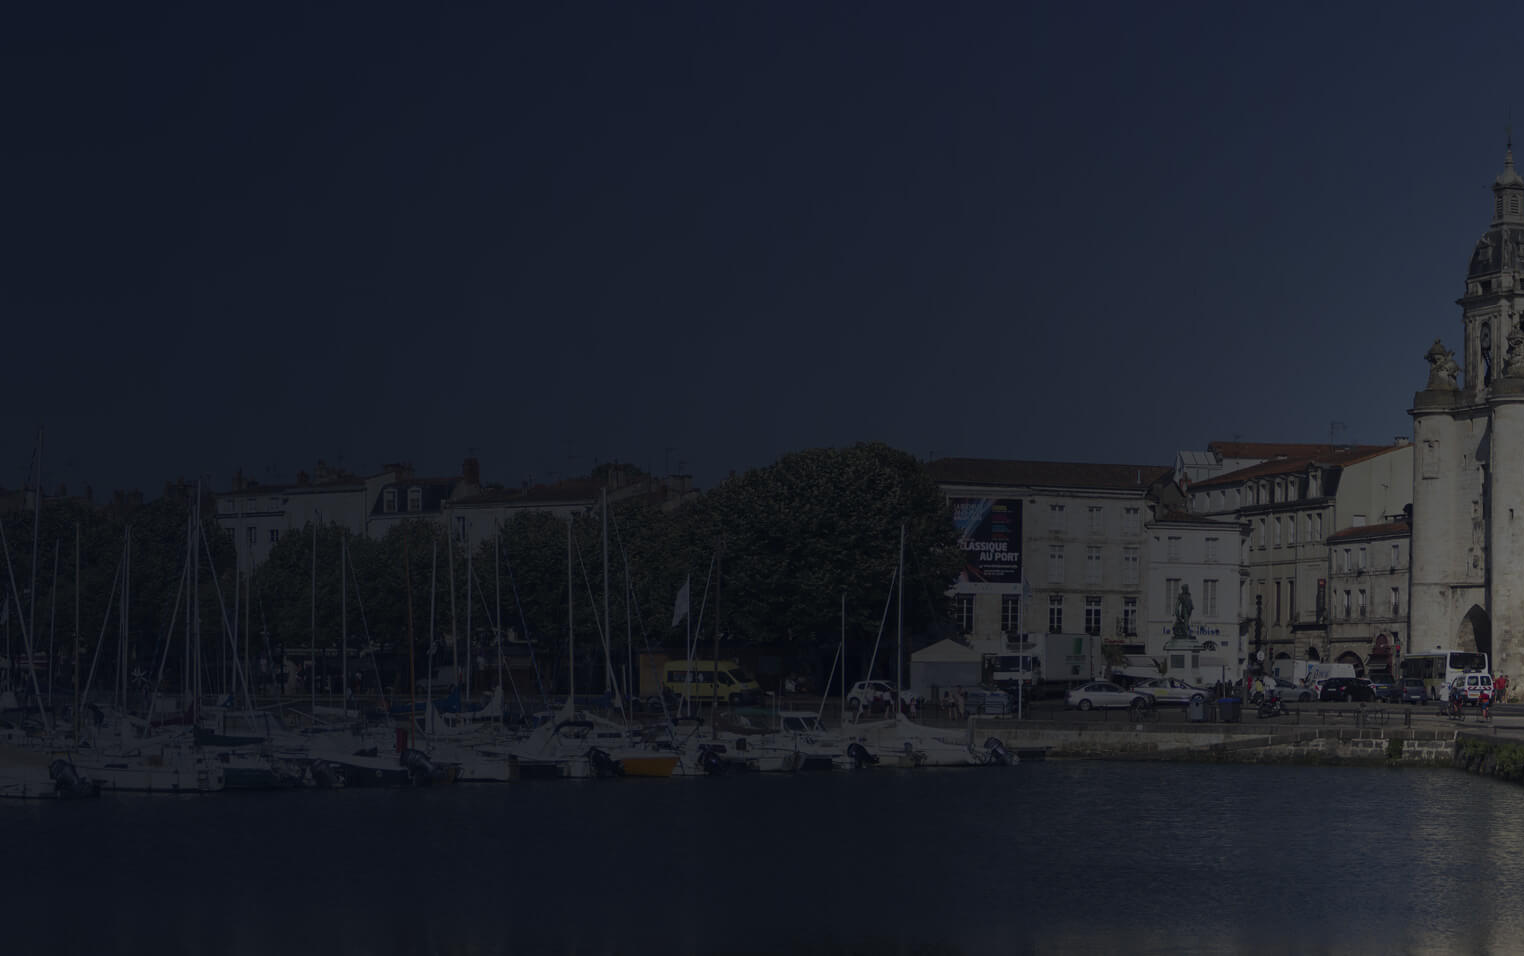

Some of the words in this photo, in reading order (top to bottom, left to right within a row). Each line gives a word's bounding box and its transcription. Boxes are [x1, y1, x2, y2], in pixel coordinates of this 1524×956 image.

[960, 541, 1008, 553] CLASSIQUE
[980, 552, 993, 561] AU
[994, 552, 1019, 562] PORT
